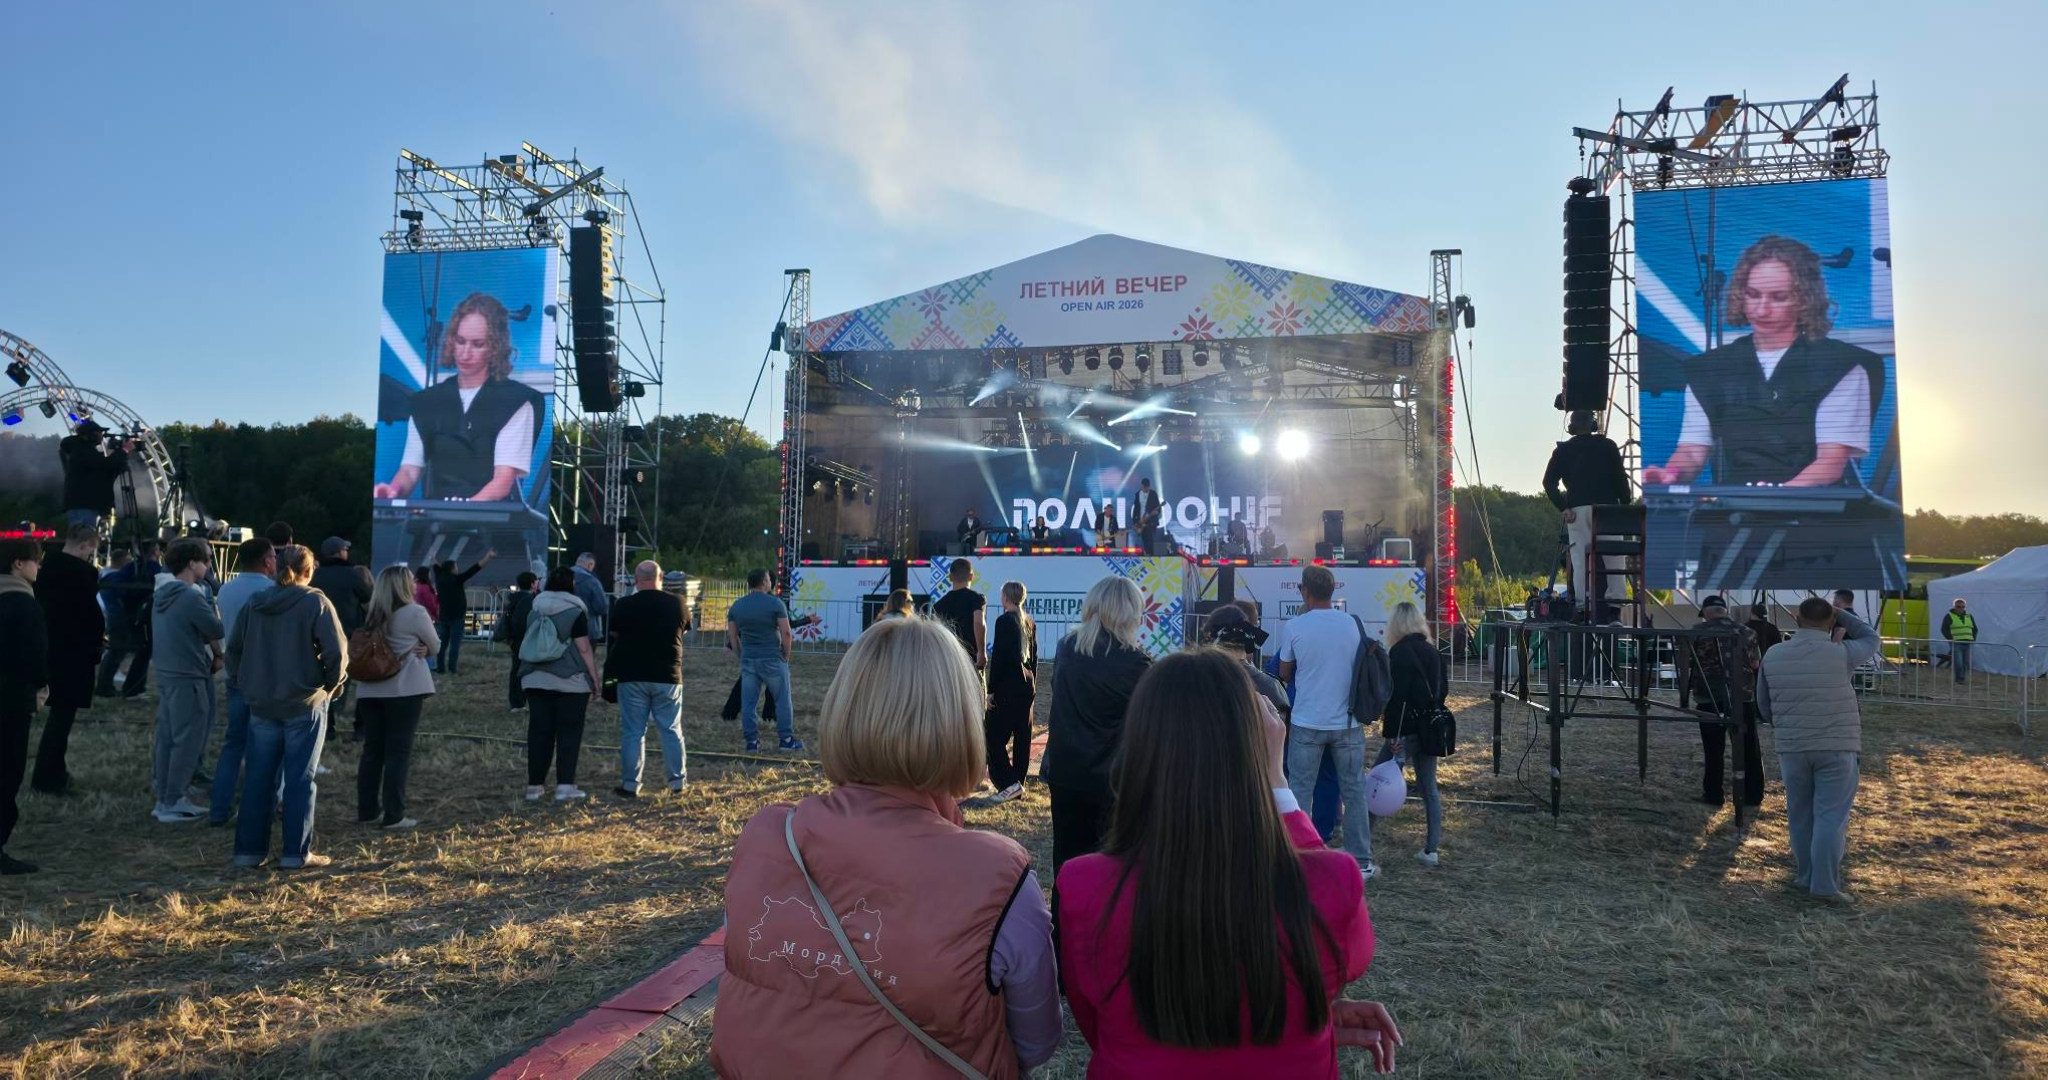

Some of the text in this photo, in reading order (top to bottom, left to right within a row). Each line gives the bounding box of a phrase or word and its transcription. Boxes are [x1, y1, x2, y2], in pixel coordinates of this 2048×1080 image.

[1019, 275, 1188, 299] ЛЕТНИЙ ВЕЧЕР
[1061, 299, 1144, 312] OPEN AIR 2026
[1024, 598, 1083, 615] МЕЛЕГРА
[781, 940, 898, 986] Мордия
